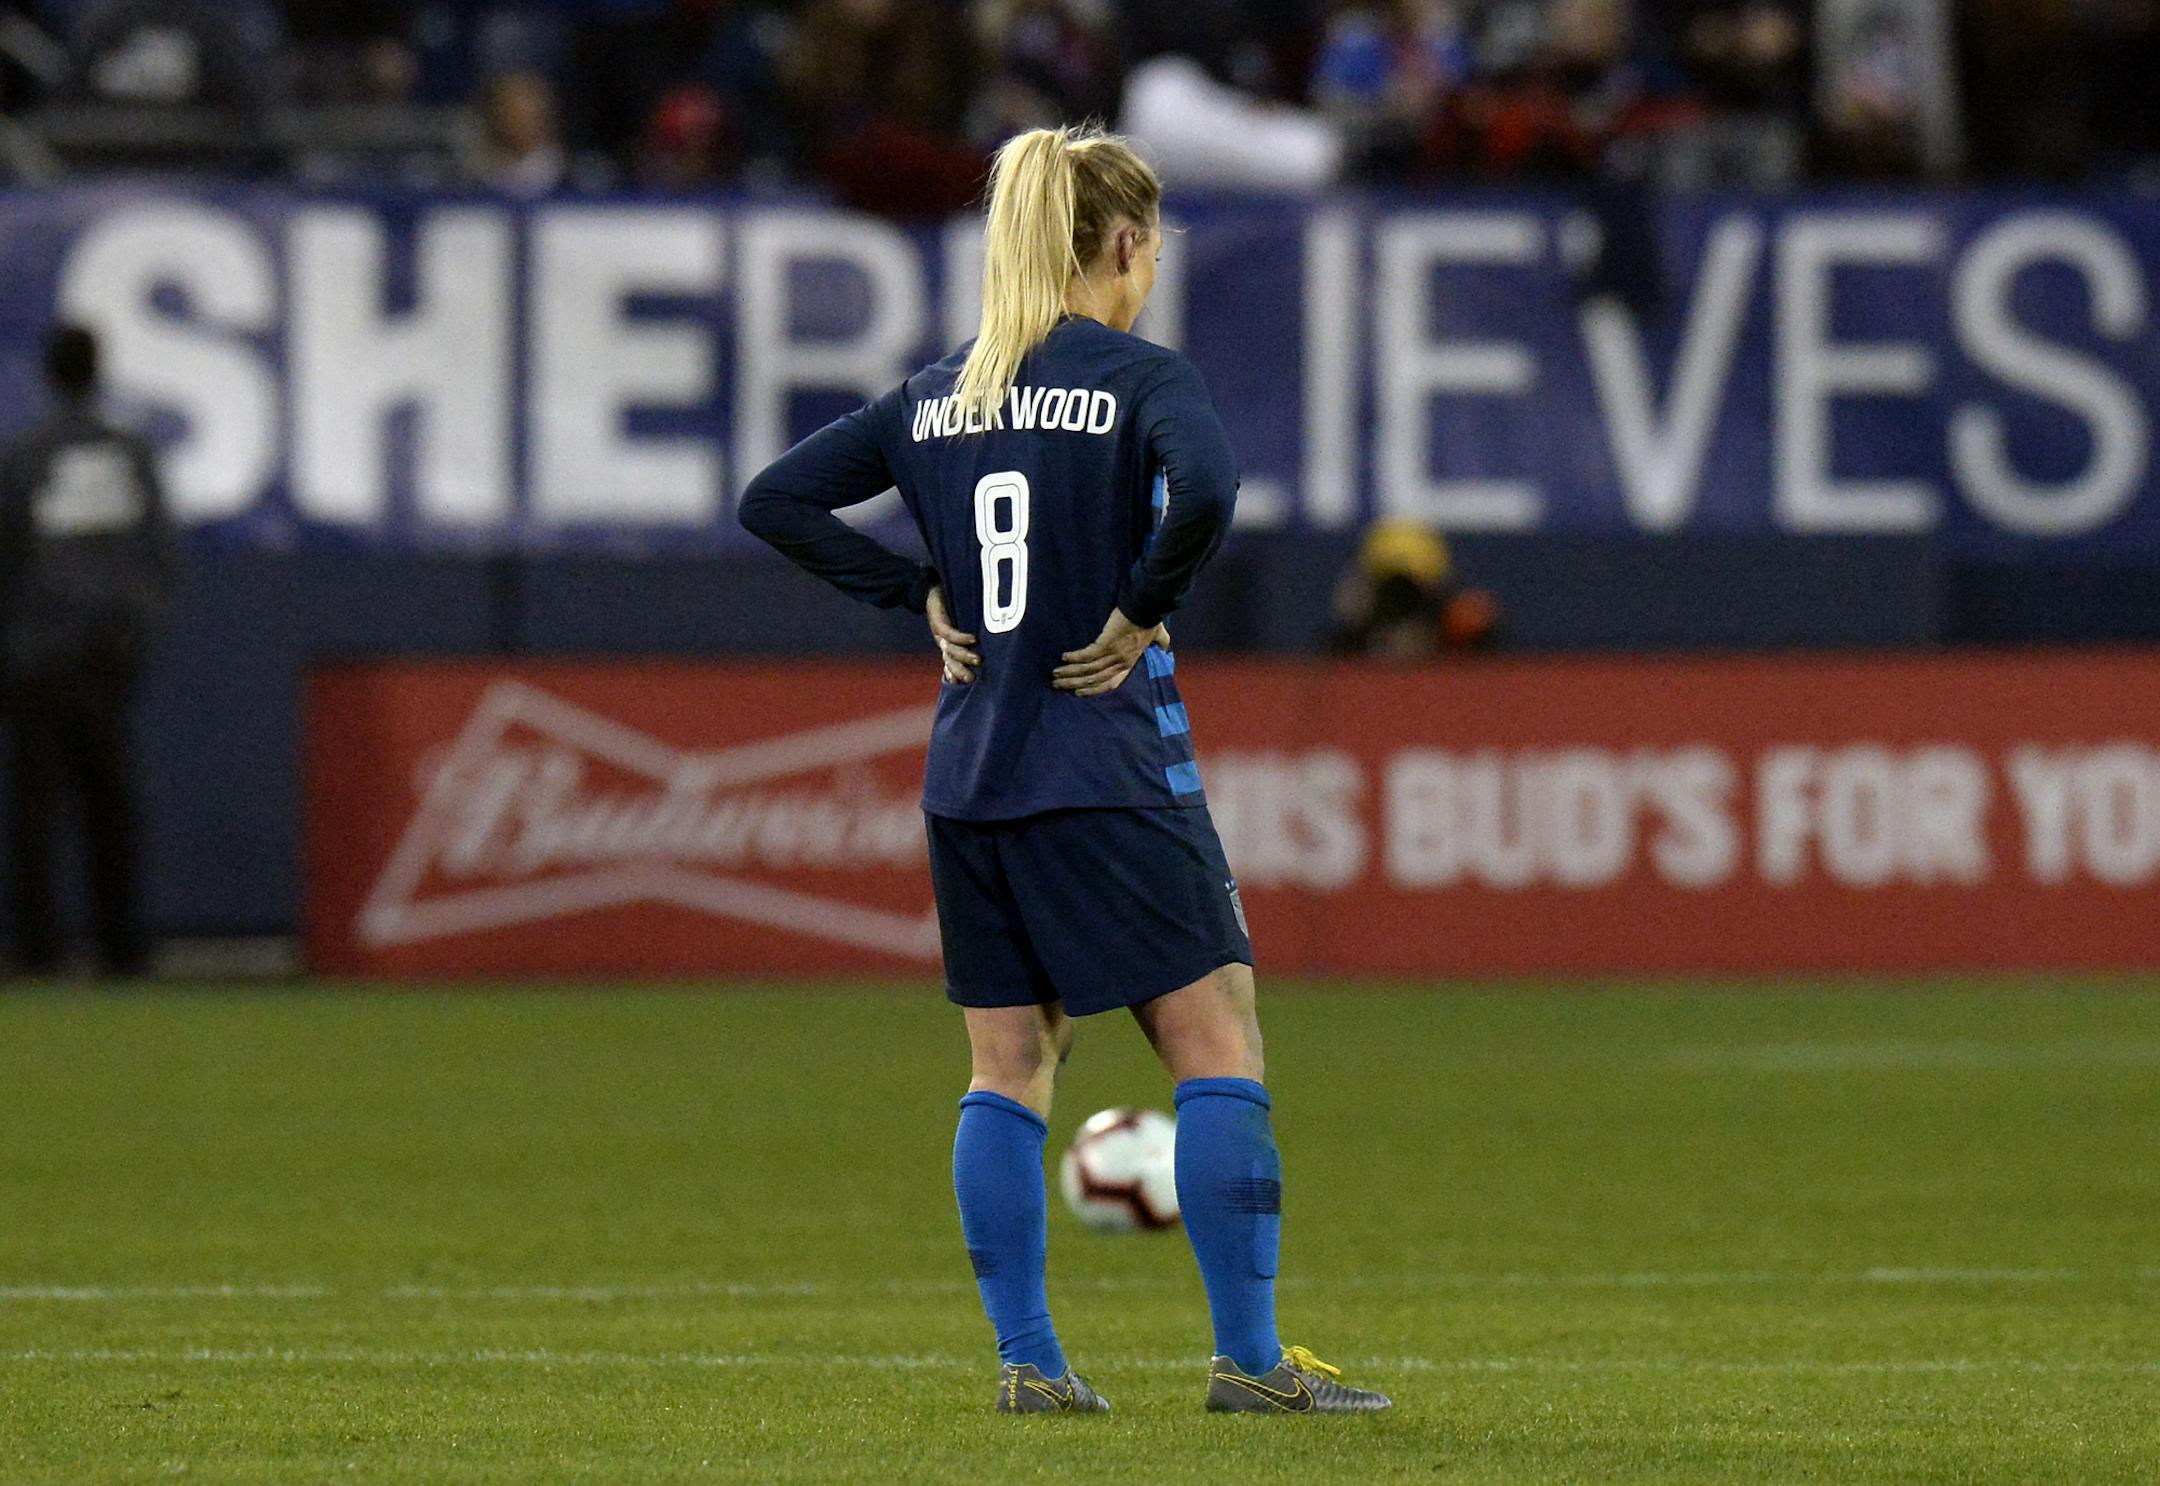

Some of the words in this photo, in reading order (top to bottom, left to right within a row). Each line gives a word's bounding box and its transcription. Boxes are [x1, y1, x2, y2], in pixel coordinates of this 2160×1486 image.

[60, 202, 2150, 536] SHEBIEVES
[912, 386, 1118, 442] UNDERWOOD
[974, 470, 1030, 634] 8
[1384, 746, 1740, 890] BUD'S
[1758, 742, 1990, 886] FOR
